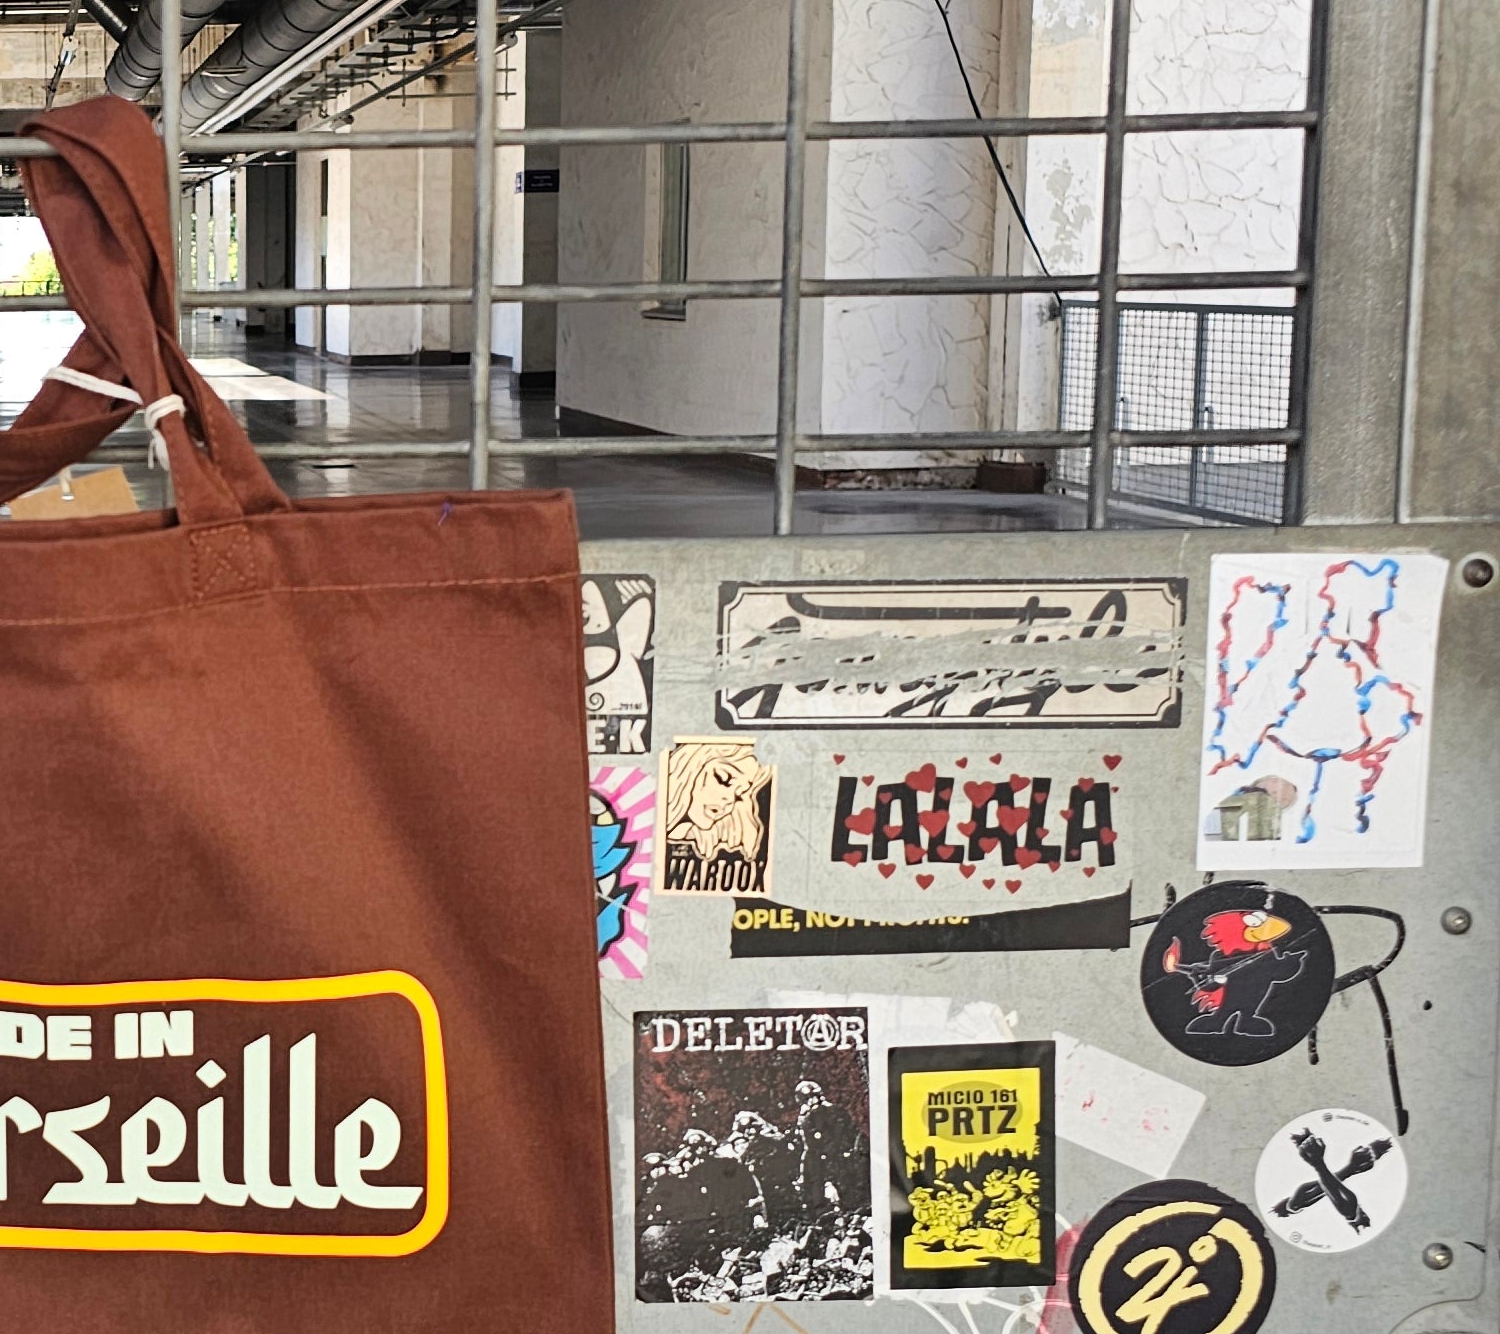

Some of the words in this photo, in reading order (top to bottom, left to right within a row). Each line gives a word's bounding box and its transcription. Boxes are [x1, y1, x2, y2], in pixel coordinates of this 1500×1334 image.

[831, 776, 1116, 867] LALALA
[113, 1009, 195, 1061] IN
[928, 1088, 984, 1105] MICIO
[991, 1088, 1018, 1104] 161
[927, 1103, 1019, 1137] PRTZ
